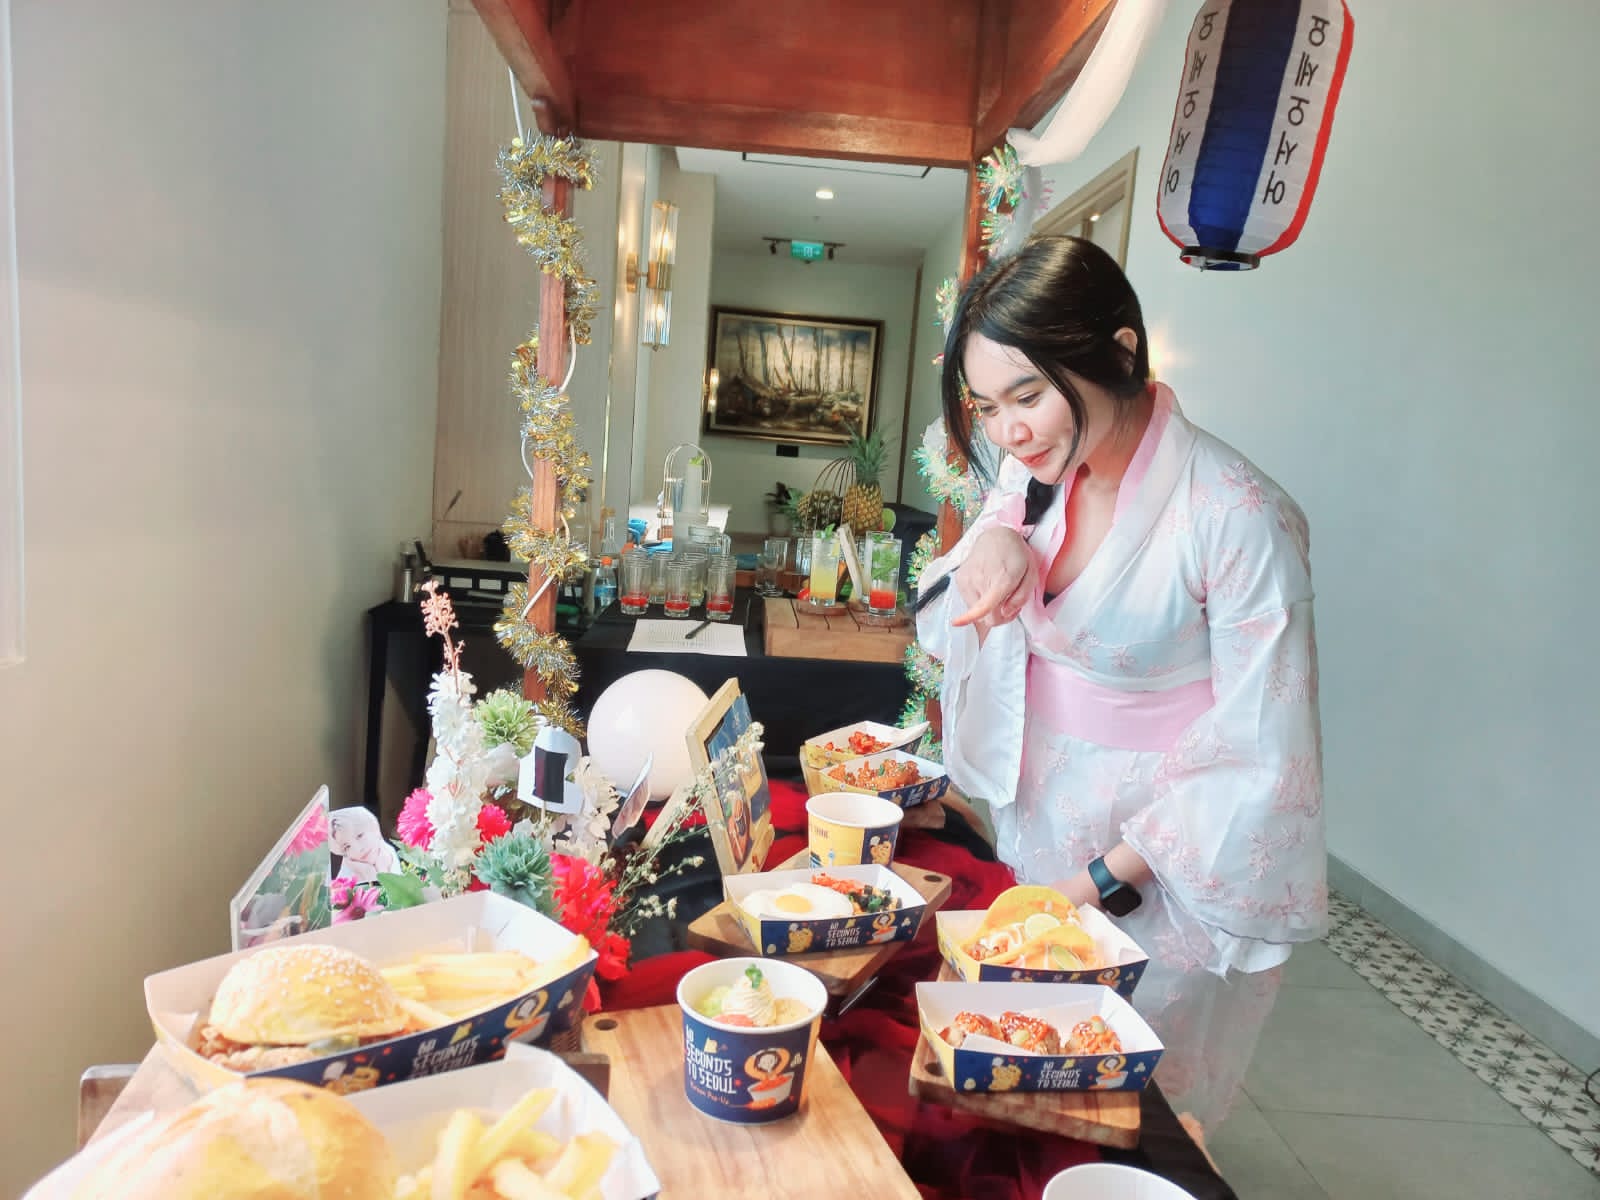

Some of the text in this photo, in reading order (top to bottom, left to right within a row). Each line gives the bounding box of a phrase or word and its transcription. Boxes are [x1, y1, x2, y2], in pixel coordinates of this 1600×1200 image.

[828, 927, 860, 938] SECONDS
[685, 1039, 733, 1076] SECONDS
[686, 1058, 737, 1095] TO SEOUL
[1040, 1069, 1082, 1080] SECONDS
[1037, 1079, 1080, 1089] TO SEOUL
